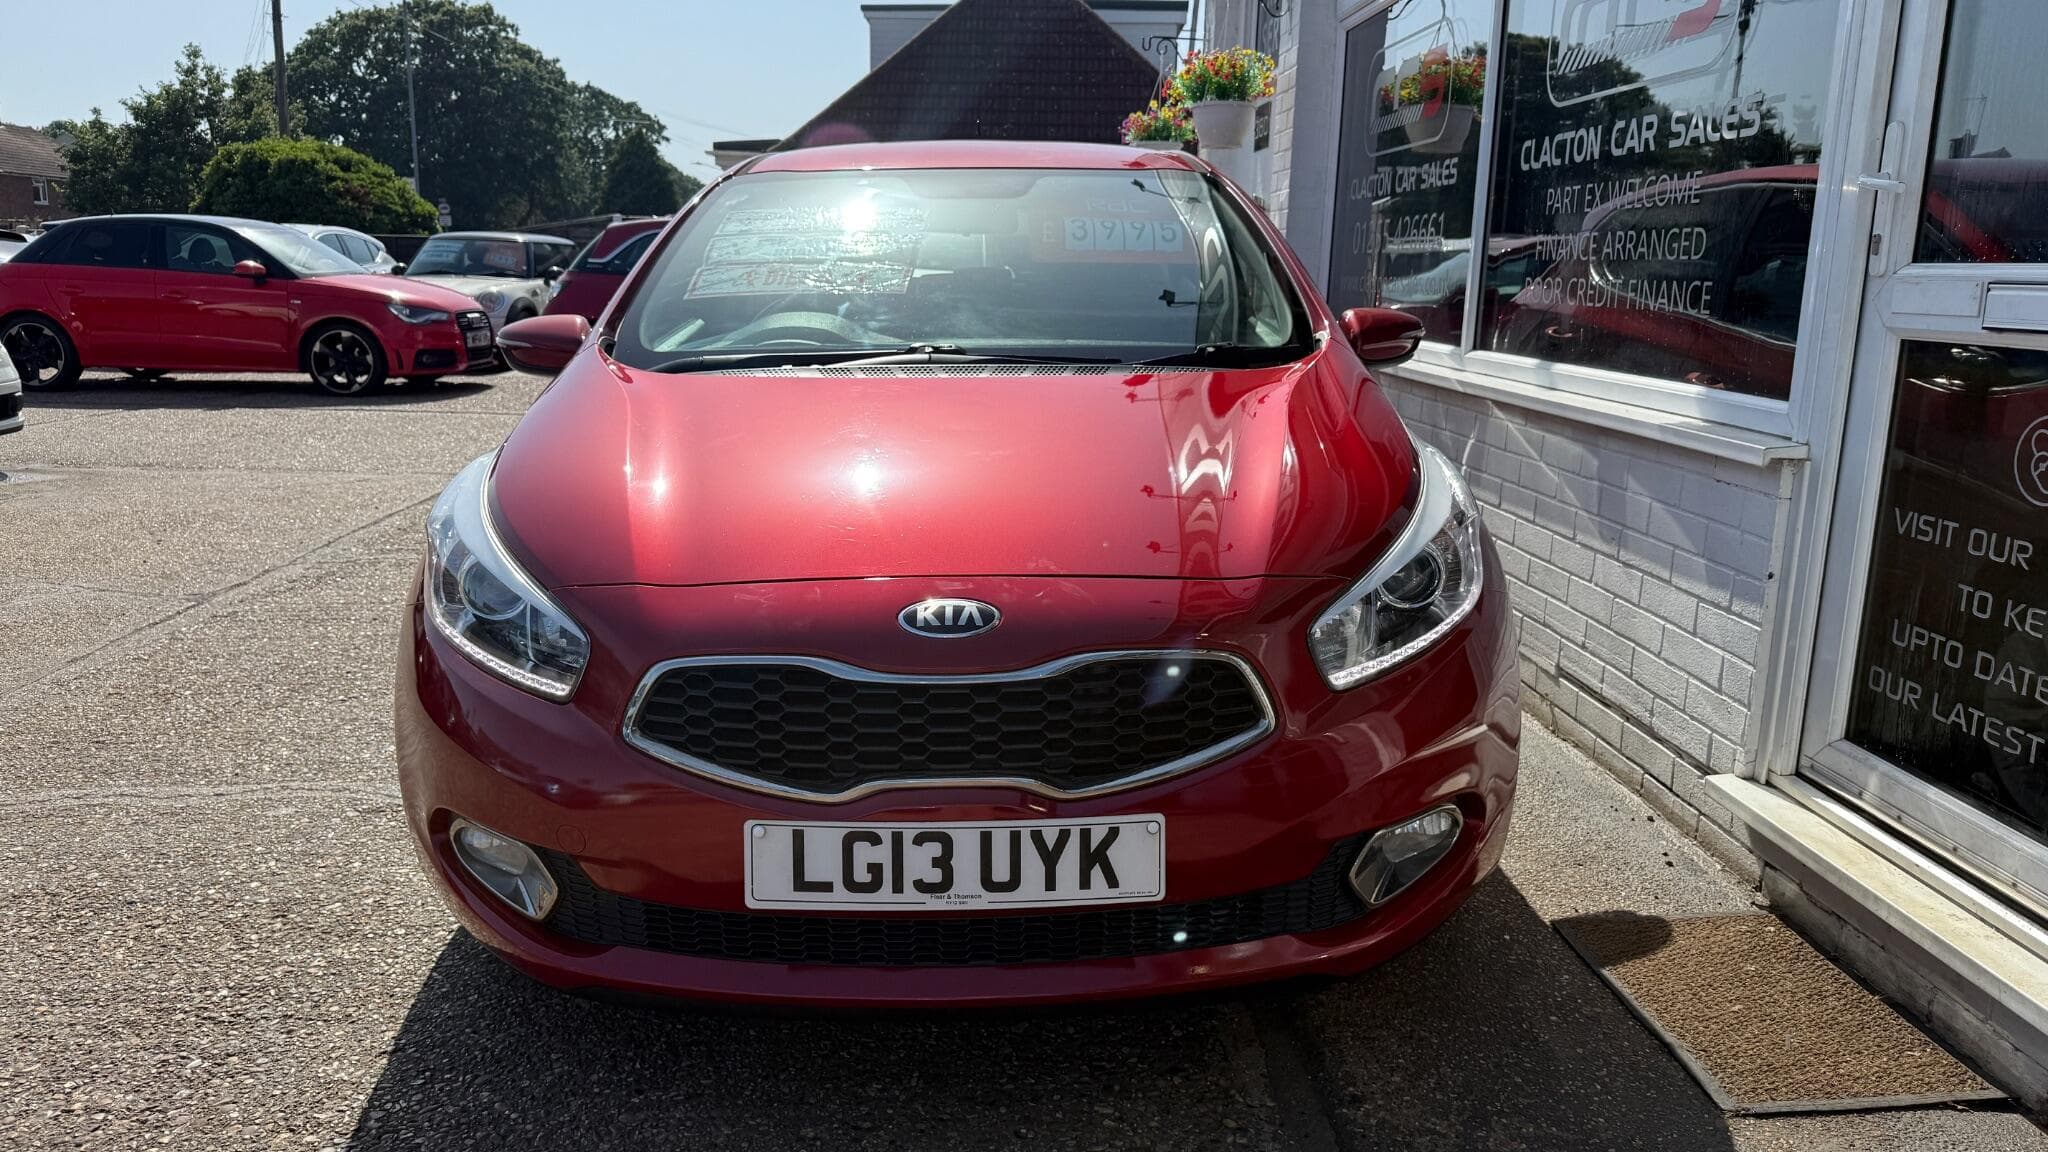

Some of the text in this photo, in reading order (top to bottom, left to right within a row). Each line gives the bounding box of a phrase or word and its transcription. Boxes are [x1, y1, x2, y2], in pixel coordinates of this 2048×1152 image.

[1520, 95, 1762, 171] CLACTON CAR SALES
[1351, 157, 1459, 199] CLACTON CAR SALES
[1546, 170, 1703, 215] PART EX WELCOME
[1536, 227, 1707, 262] FINANCE ARRANGED
[1525, 277, 1713, 314] POOR CREDIT FINANCE
[1894, 507, 2034, 571] VISIT OUR
[916, 604, 984, 627] KIA
[1957, 583, 1993, 619] TO
[1892, 618, 2048, 706] UPTO DATE
[1868, 665, 2046, 764] OUR LATEST
[792, 826, 1120, 895] LG13 UYK
